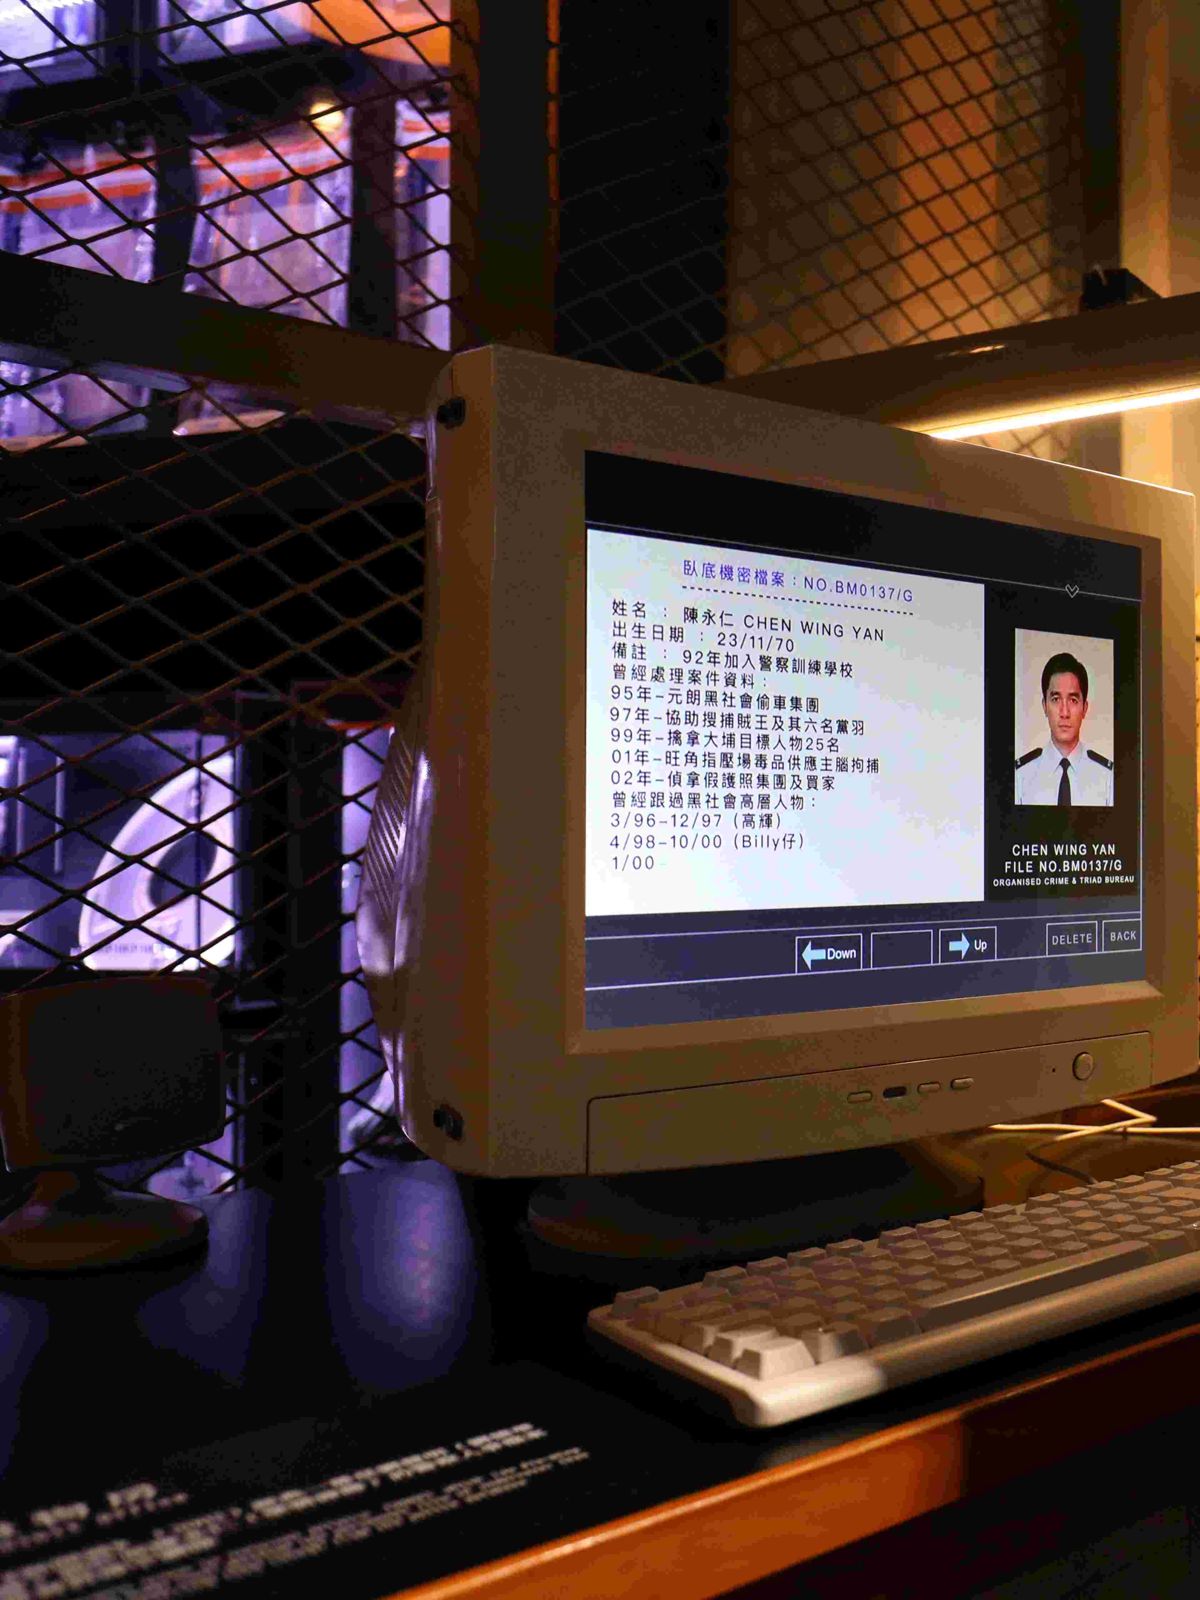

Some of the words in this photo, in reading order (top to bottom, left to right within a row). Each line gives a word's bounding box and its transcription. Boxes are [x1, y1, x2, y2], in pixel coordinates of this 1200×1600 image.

[683, 606, 734, 628] 陳永仁
[743, 614, 792, 632] CHEN
[801, 621, 844, 638] WING
[852, 626, 884, 642] YAN
[717, 632, 795, 652] 23/11/70
[683, 649, 853, 678] 92年加入警察訓練學校
[1012, 844, 1048, 857] CHEN
[1053, 843, 1087, 856] WING
[1092, 843, 1116, 855] YAN
[1004, 860, 1033, 873] FILE
[1039, 859, 1122, 873] NO.BM0137/G
[992, 877, 1042, 887] ORGANISED
[1044, 877, 1069, 885] CRIME
[1072, 877, 1076, 885] &
[1079, 876, 1102, 884] TRIAD
[1104, 875, 1135, 884] BUREAU
[1051, 932, 1093, 946] DELETE
[1110, 931, 1137, 942] BACK
[974, 939, 988, 953] Up
[827, 947, 857, 961] Down
